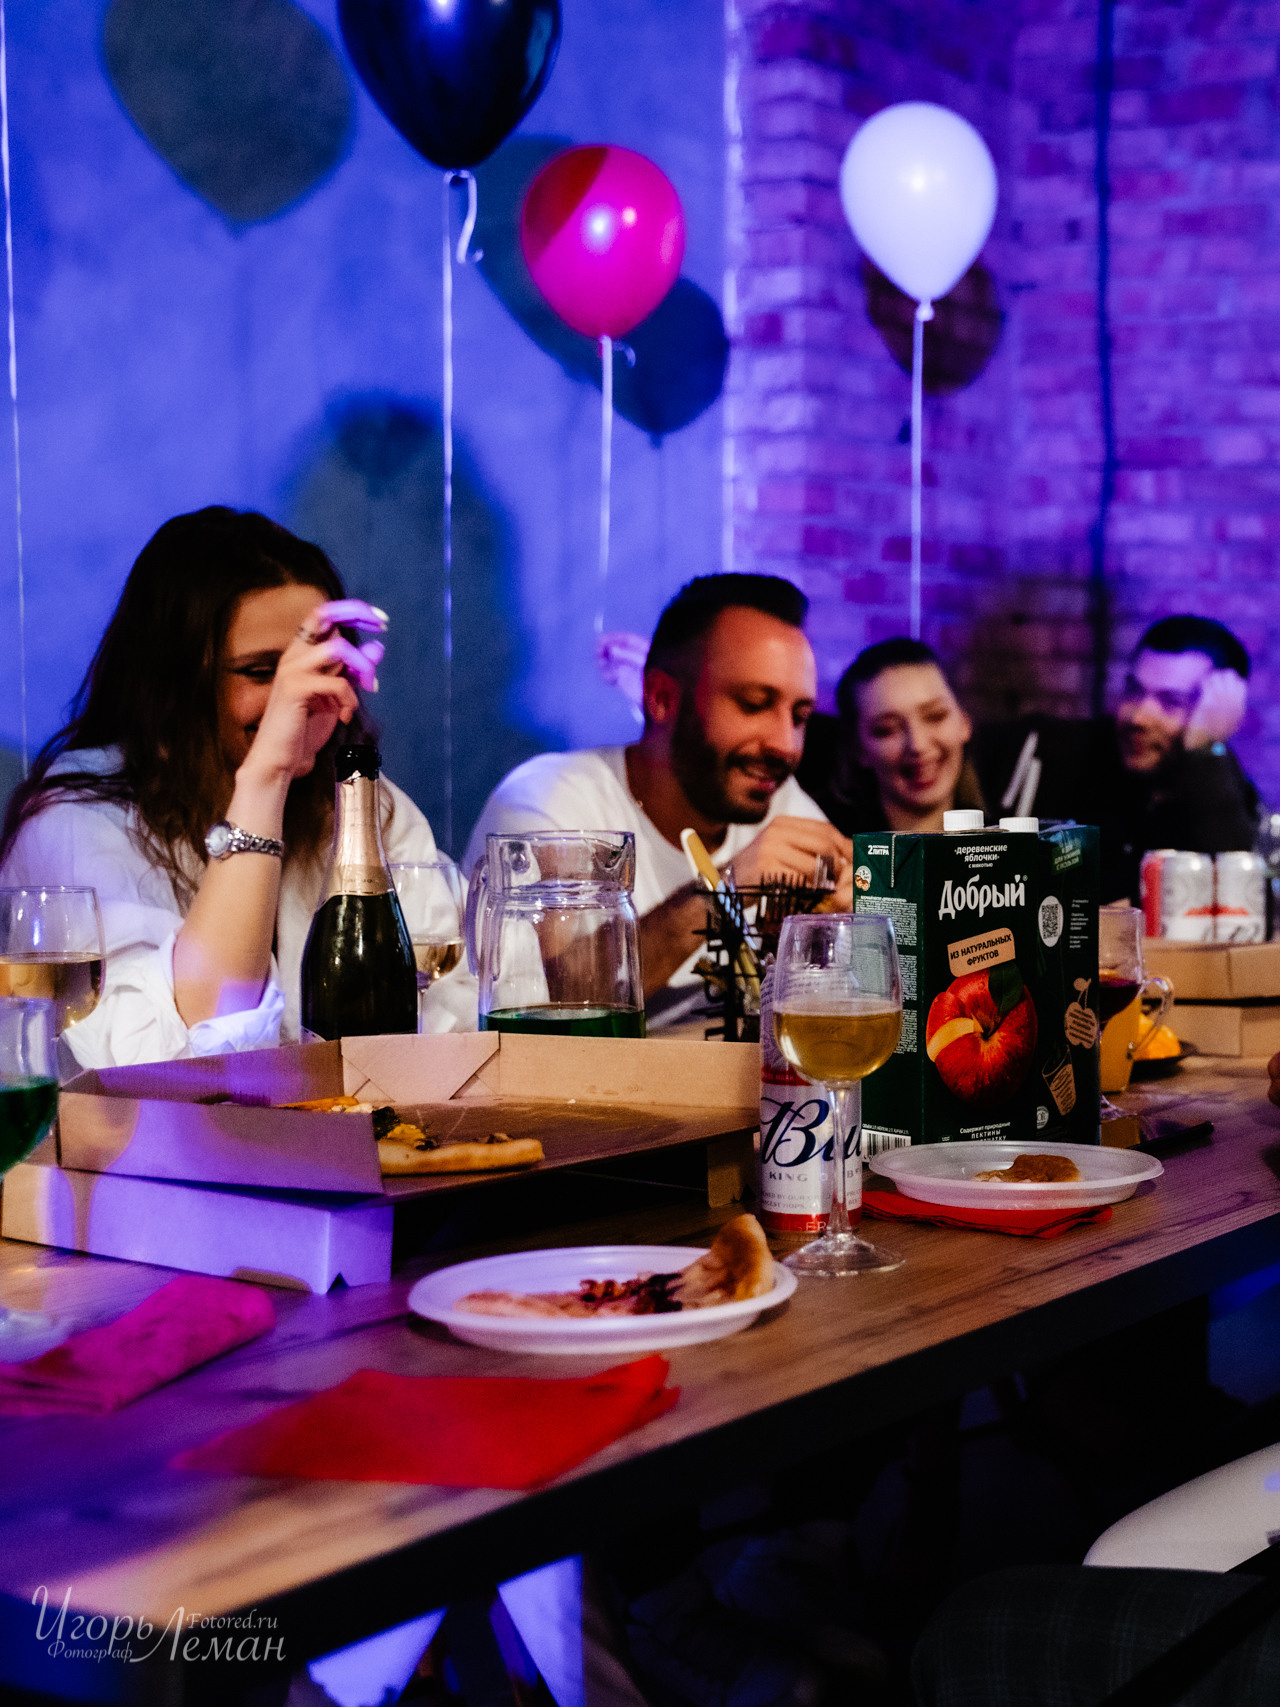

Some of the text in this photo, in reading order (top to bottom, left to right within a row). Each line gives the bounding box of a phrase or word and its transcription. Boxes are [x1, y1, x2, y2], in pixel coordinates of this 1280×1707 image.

[868, 845, 873, 855] 2
[938, 874, 1026, 921] Добрый
[950, 934, 1012, 960] ИЗ НАТУРАЛЬНЫХ
[967, 949, 999, 966] ФРУКТОВ
[971, 1129, 1001, 1139] ПЕКТИНЫ
[769, 1171, 808, 1182] KING
